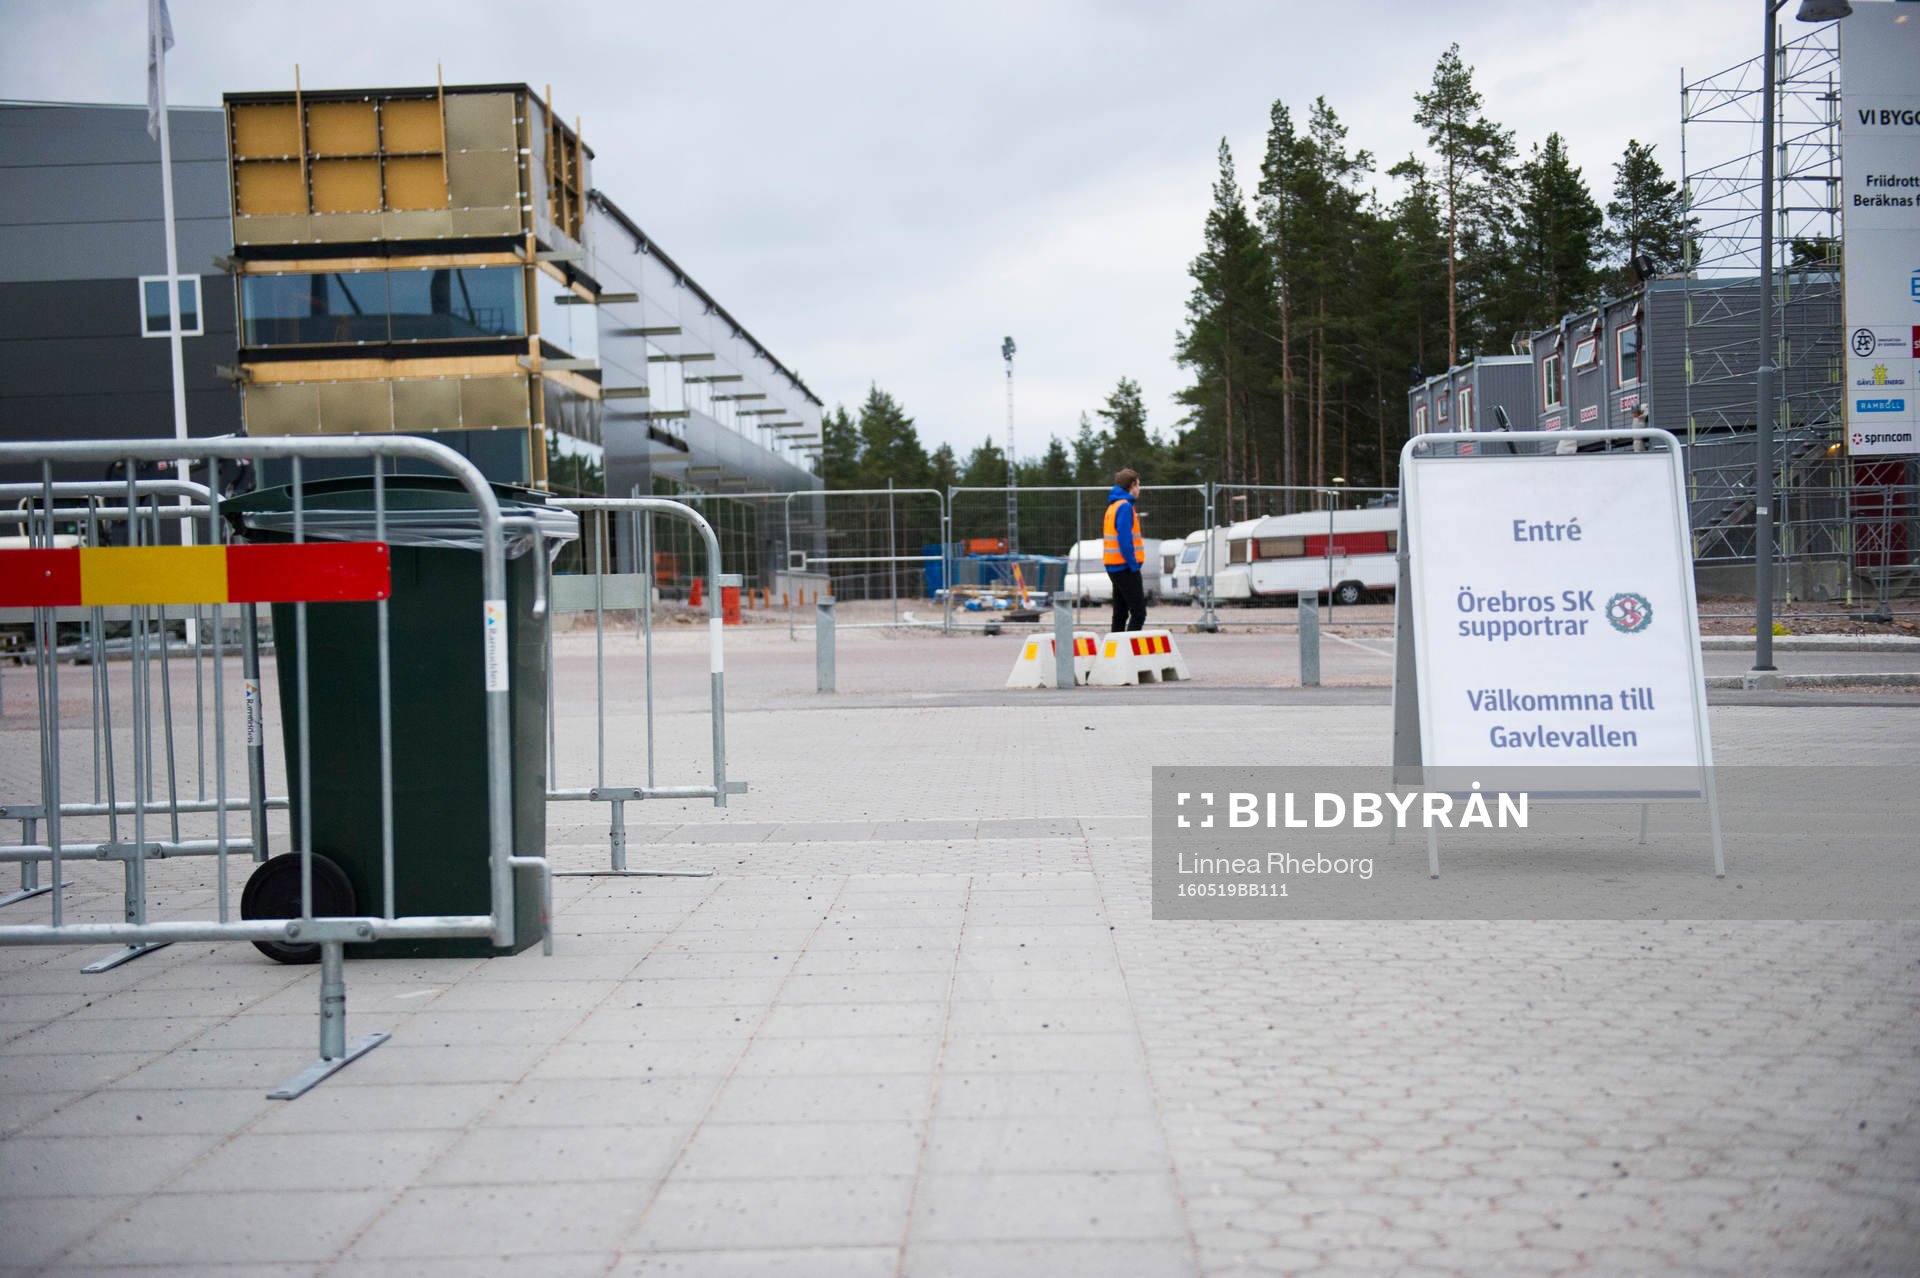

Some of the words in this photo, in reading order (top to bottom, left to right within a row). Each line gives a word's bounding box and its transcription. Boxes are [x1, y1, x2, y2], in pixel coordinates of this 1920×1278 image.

[1858, 110, 1876, 125] VI
[1854, 194, 1913, 207] Beräknas
[1865, 433, 1912, 445] sprincom
[1513, 517, 1582, 542] Entré
[1457, 586, 1555, 613] Örebros
[1562, 590, 1595, 612] SK
[1458, 615, 1589, 642] supportrar
[1467, 688, 1614, 712] Välkommna
[1620, 687, 1655, 711] till
[1489, 724, 1638, 748] Gavlevallen
